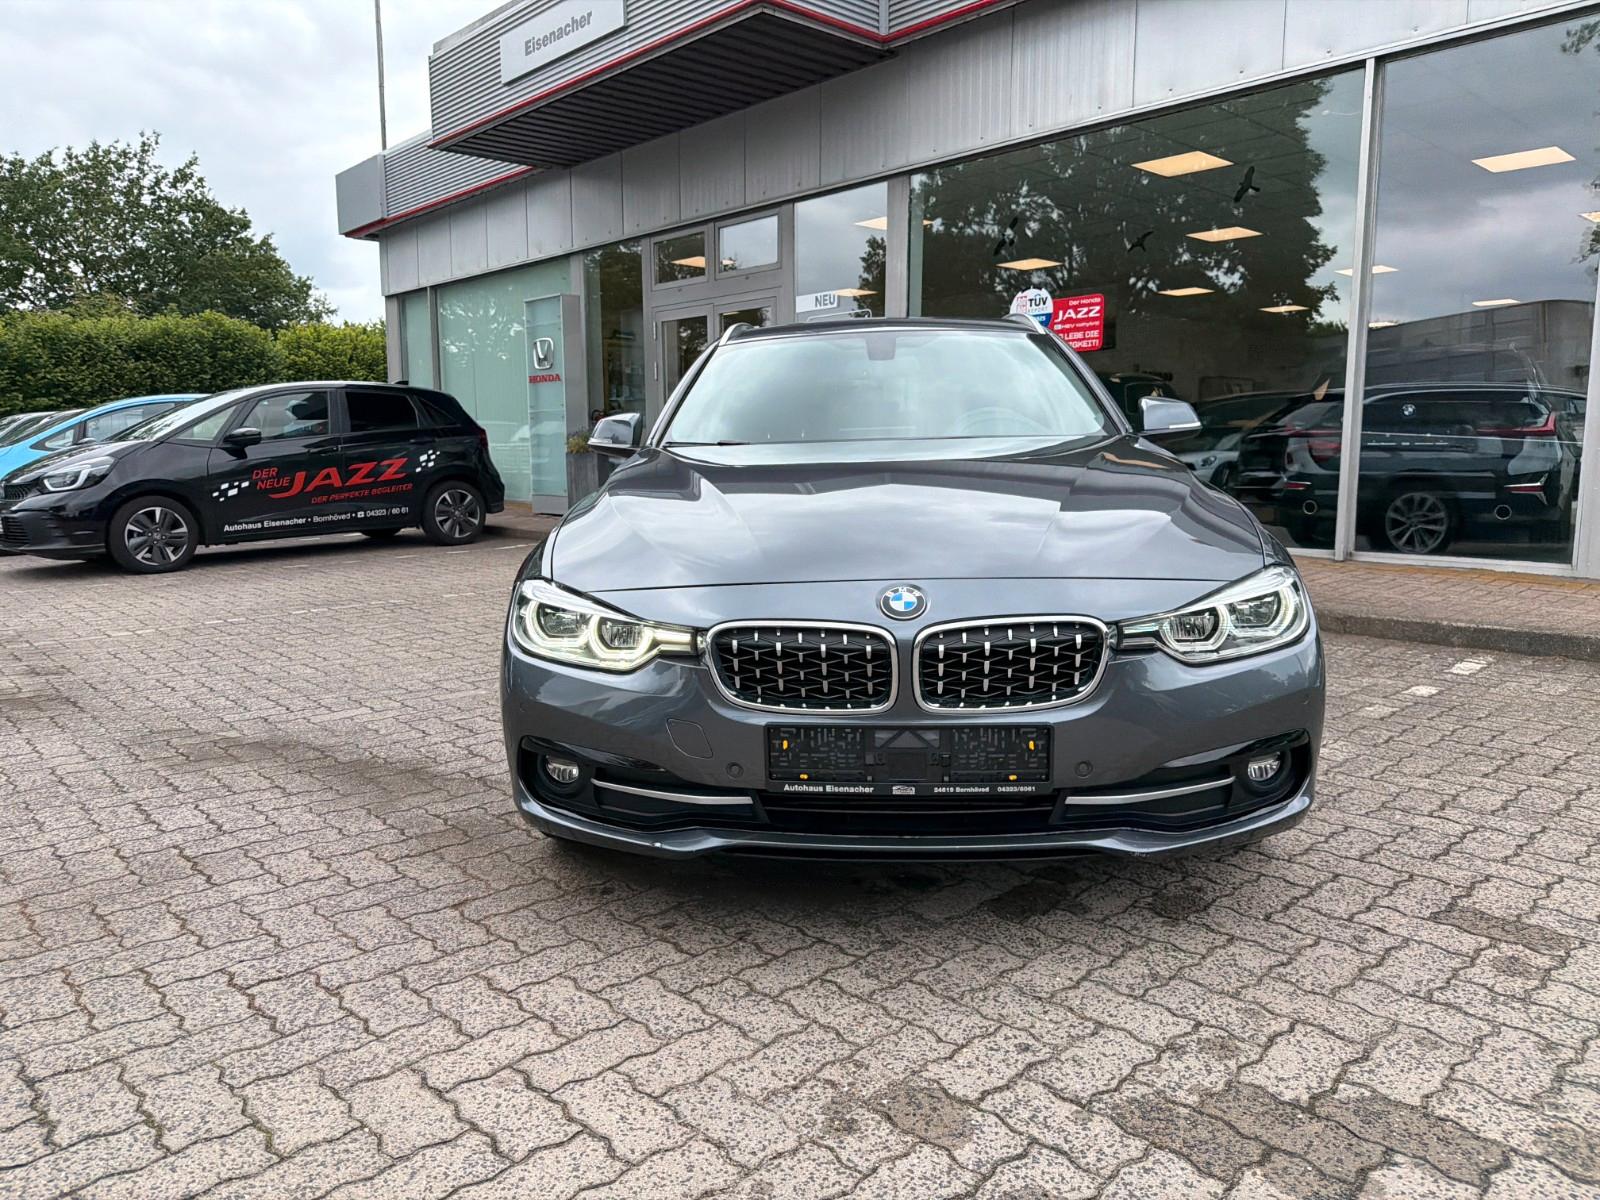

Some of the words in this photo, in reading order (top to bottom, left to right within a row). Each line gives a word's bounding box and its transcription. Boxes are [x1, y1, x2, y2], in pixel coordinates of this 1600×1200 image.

[524, 11, 593, 56] Eisenacher
[815, 294, 836, 308] NEU
[1054, 306, 1100, 322] JAZZ
[1064, 331, 1085, 340] LEBE
[1085, 329, 1100, 338] DIE
[528, 374, 561, 384] HONDA
[252, 467, 278, 480] DER
[268, 457, 409, 499] JAZZ
[256, 476, 291, 490] NEUE
[311, 495, 329, 504] DER
[329, 489, 370, 500] PERFEKTE
[371, 484, 412, 494] BEGLEITER
[223, 523, 262, 532] Autohaus
[263, 517, 306, 528] Eisenacher
[312, 513, 351, 523] Bornhöved
[366, 508, 387, 517] 04323
[391, 507, 401, 515] 60
[400, 506, 409, 514] 61
[784, 784, 824, 792] Autohaus
[825, 785, 875, 793] Eisenacher
